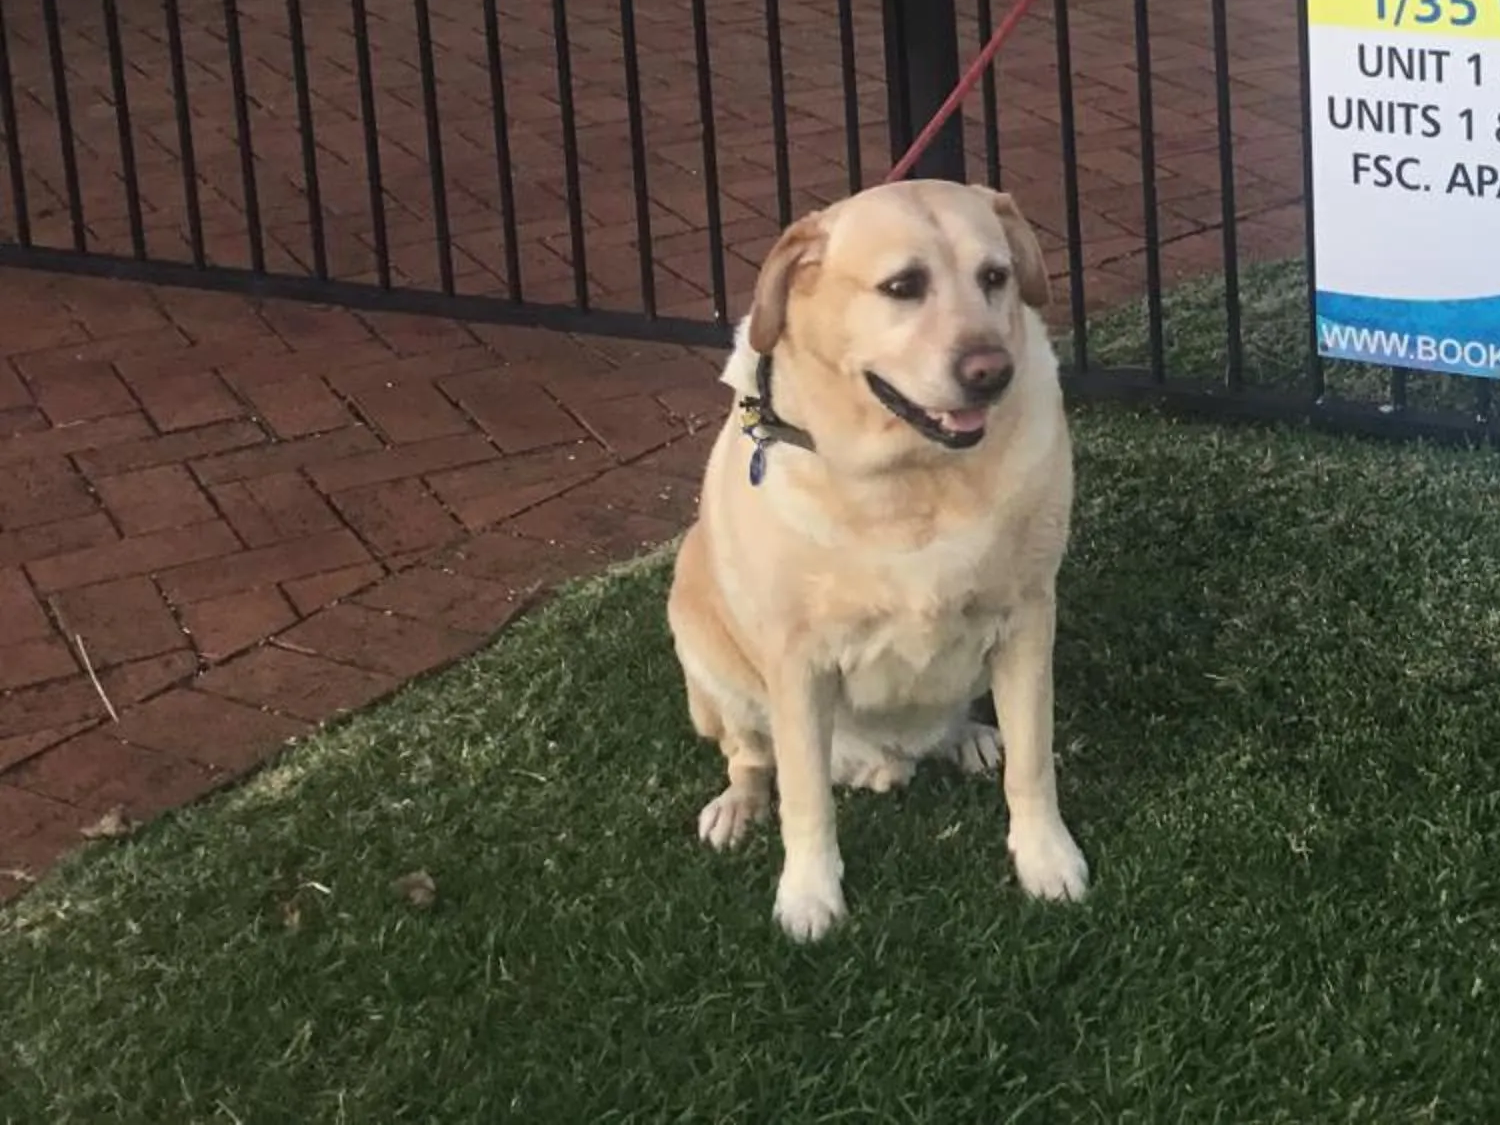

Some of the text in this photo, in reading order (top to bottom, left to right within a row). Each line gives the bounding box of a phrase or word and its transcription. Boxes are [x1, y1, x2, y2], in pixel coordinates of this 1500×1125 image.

[1357, 43, 1450, 85] UNIT
[1466, 54, 1483, 87] 1
[1327, 96, 1441, 137] UNITS
[1457, 109, 1474, 140] 1
[1351, 152, 1431, 192] FSC.
